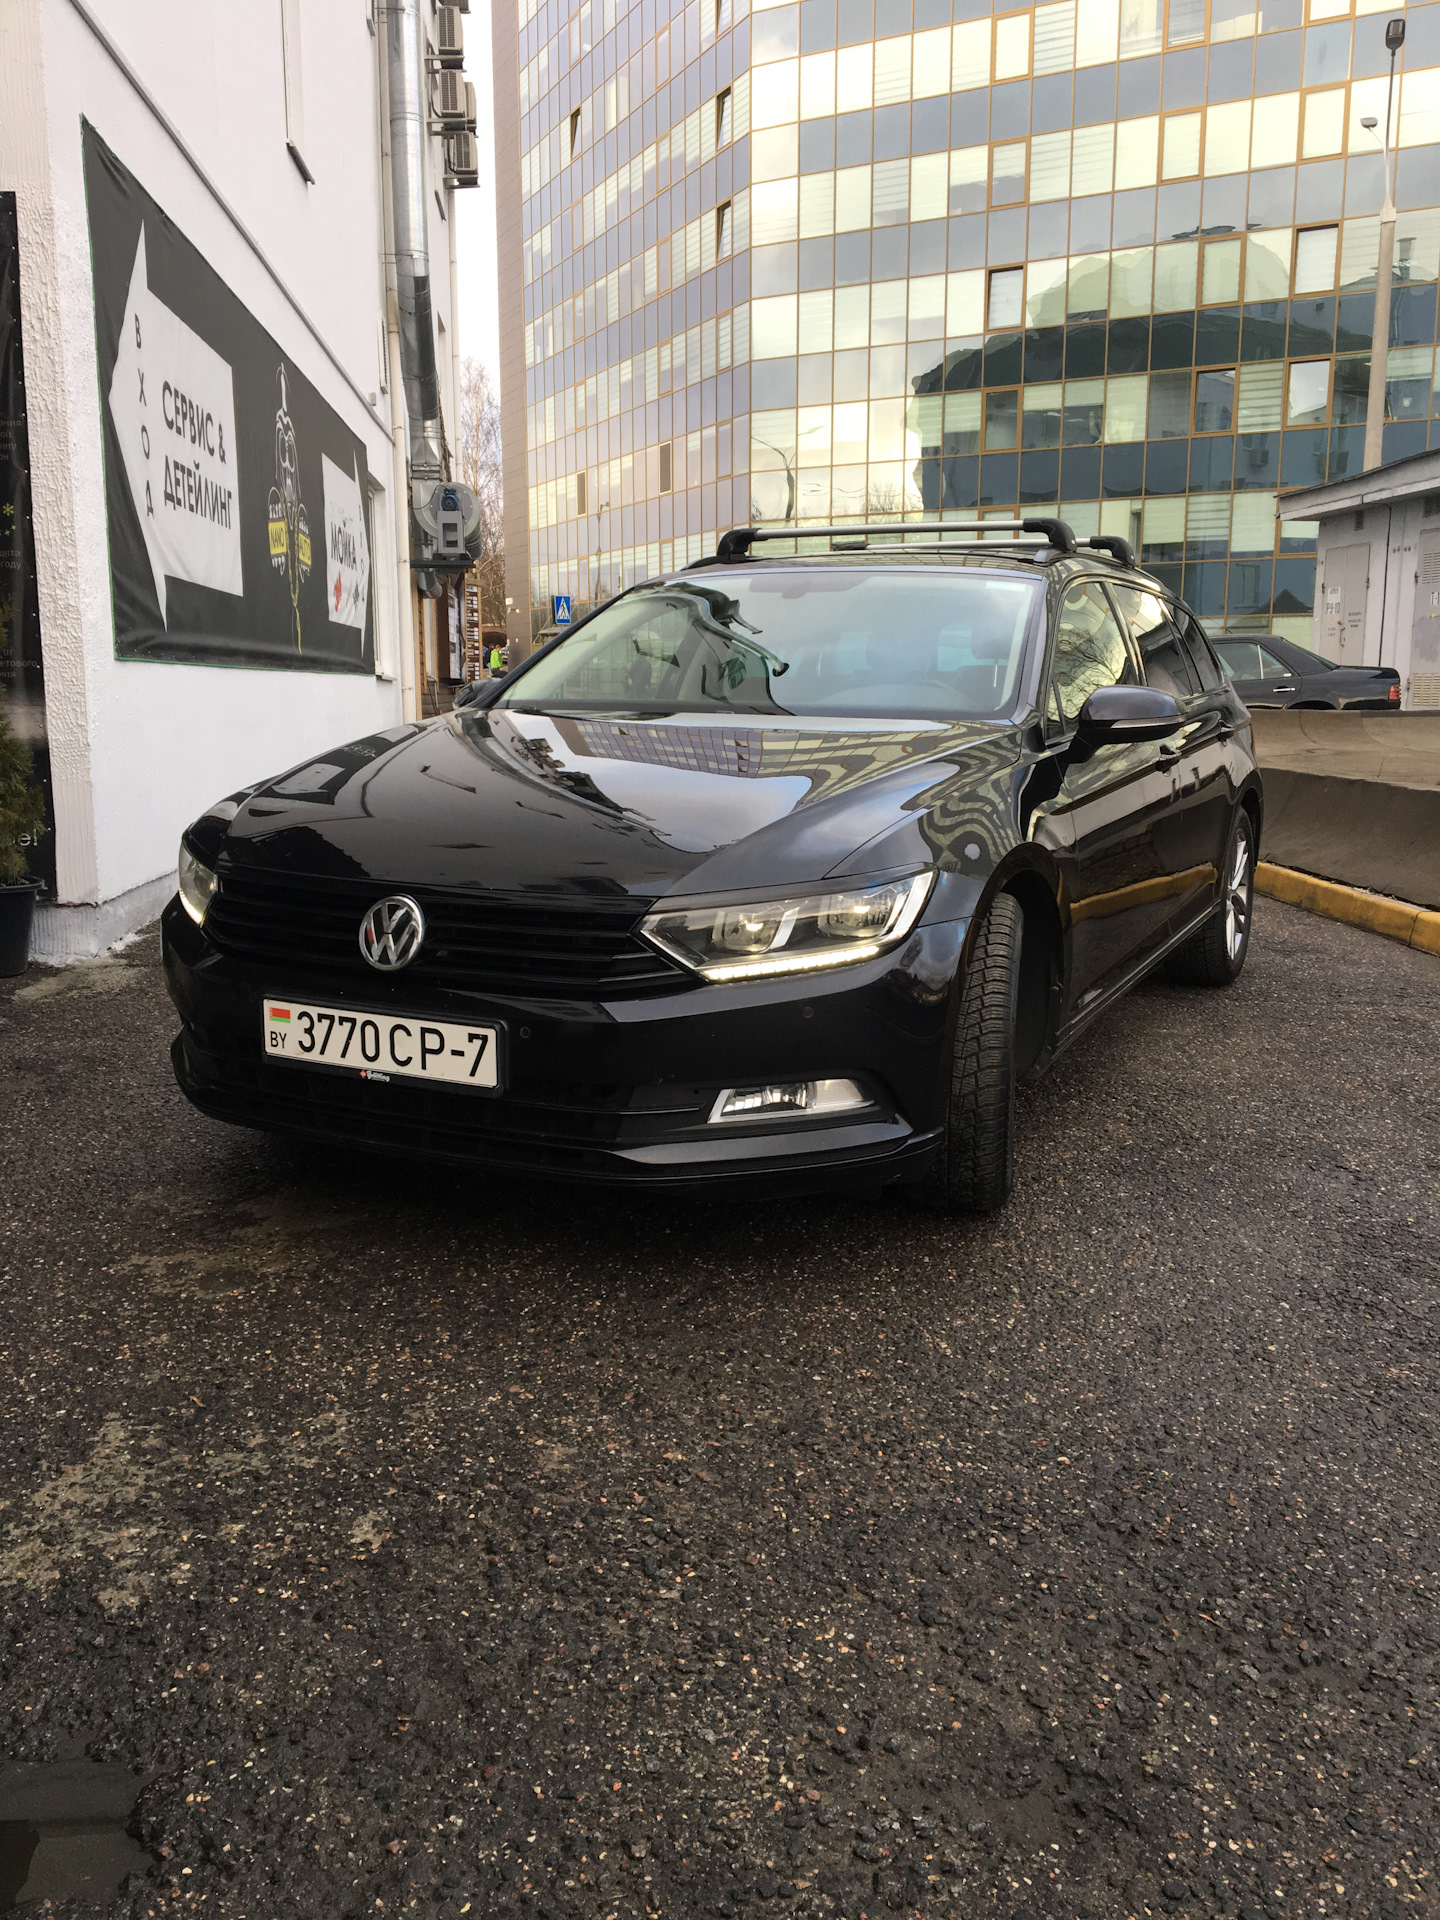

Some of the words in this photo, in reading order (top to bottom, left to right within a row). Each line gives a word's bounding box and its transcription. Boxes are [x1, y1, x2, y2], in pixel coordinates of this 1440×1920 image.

[134, 312, 154, 519] ВХОД
[162, 380, 215, 457] СЕРВИС
[218, 422, 227, 465] &
[163, 454, 233, 530] ДЕТЕЙЛИНГ
[270, 526, 285, 549] NANO
[330, 520, 358, 572] МОЙКА
[269, 1030, 287, 1049] BY
